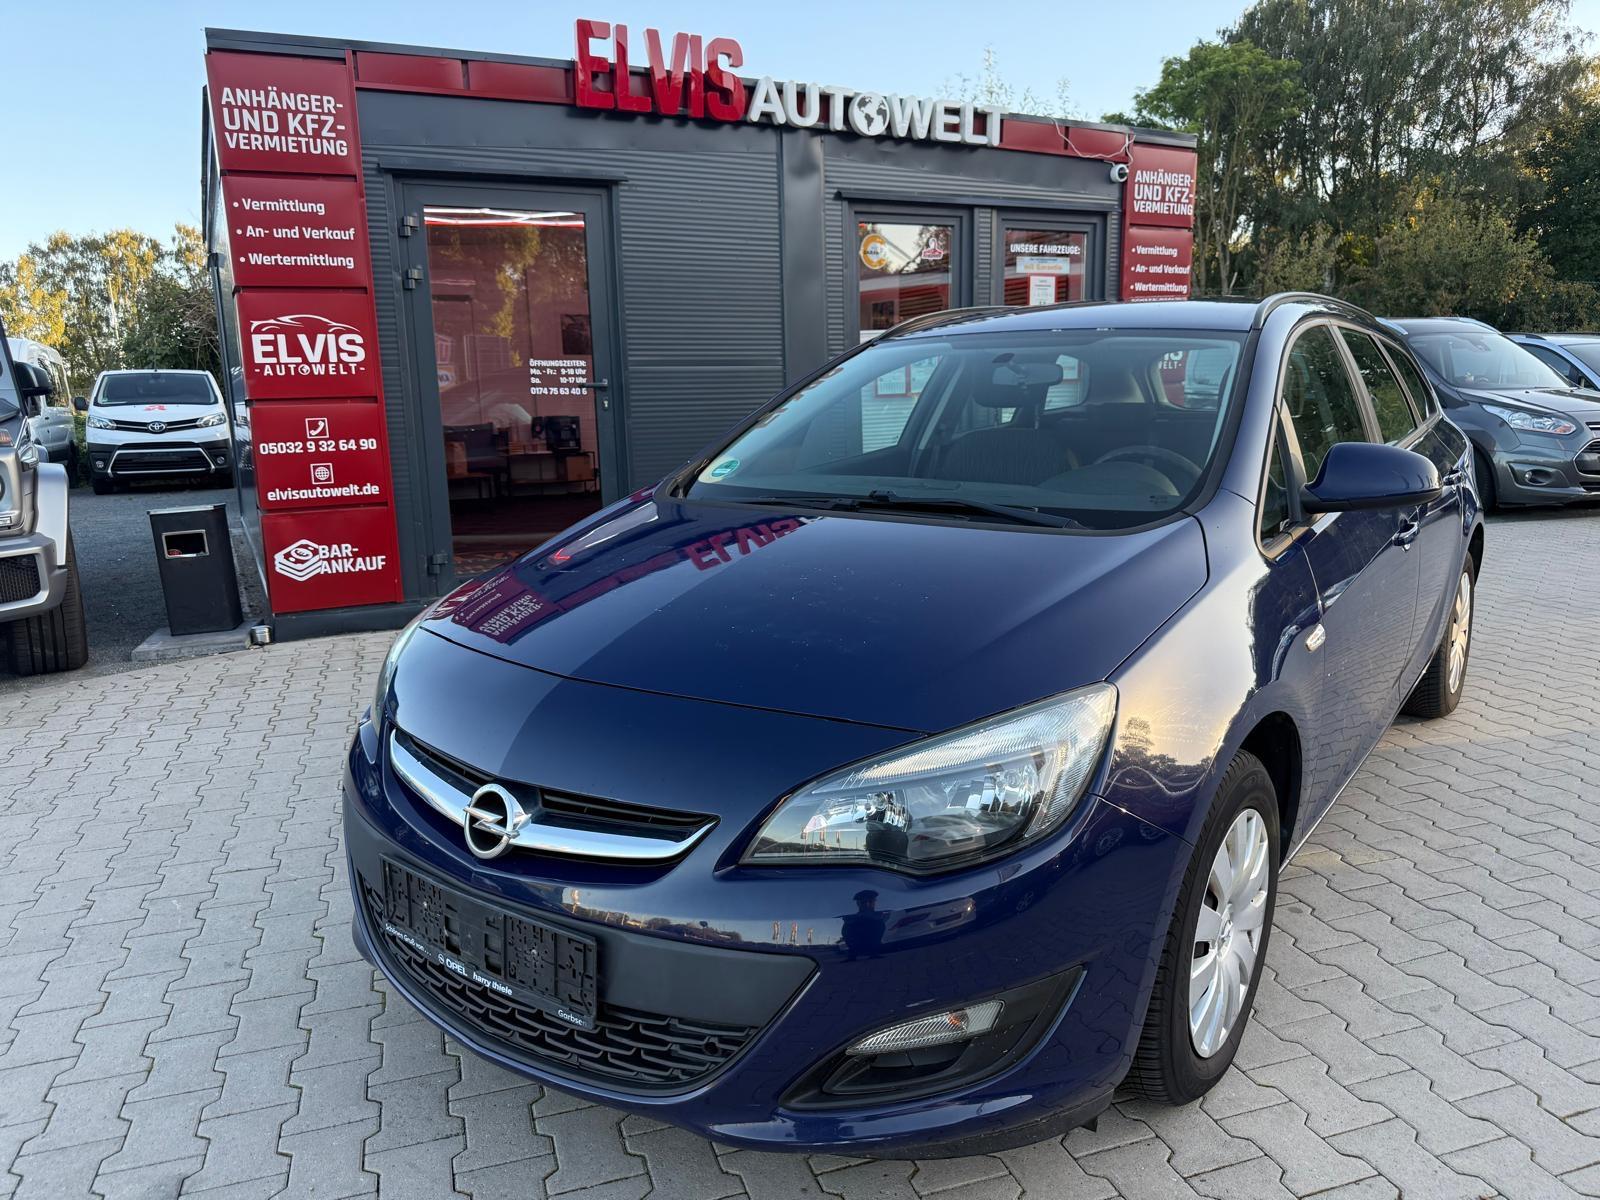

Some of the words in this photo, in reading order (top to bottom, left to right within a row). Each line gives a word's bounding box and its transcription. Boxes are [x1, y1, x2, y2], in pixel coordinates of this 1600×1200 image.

[574, 18, 745, 122] ELVIS
[747, 75, 1008, 147] AUTOWELT
[221, 86, 343, 114] ANHÄNGER-
[222, 108, 279, 133] UND
[287, 112, 346, 138] KFZ-
[224, 132, 348, 156] VERMIETUNG
[1134, 168, 1194, 187] ANHÄNGER-
[1134, 186, 1162, 200] UND
[1165, 187, 1193, 203] KFZ-
[242, 198, 325, 216] Vermittlung
[1133, 200, 1193, 216] VERMIETUNG
[246, 225, 270, 238] An-
[273, 226, 299, 239] und
[303, 227, 356, 241] Verkauf
[1010, 243, 1039, 253] UNSERE
[1040, 244, 1081, 254] FAHRZEUGE:
[1136, 245, 1178, 258] Vermittlung
[248, 252, 354, 269] Wertermittlung
[1135, 264, 1148, 272] An-
[1149, 264, 1162, 273] und
[1164, 265, 1190, 274] Verkauf
[1134, 282, 1188, 294] Wertermittlung
[251, 333, 366, 364] ELVIS
[529, 358, 587, 366] ÖFFNUNGSZEITEN:
[530, 387, 548, 395] 0174
[549, 387, 558, 395] 75
[570, 387, 581, 395] 40
[582, 387, 588, 395] 6
[259, 442, 304, 454] 05032
[306, 441, 316, 454] 9
[318, 440, 336, 453] 32
[338, 439, 358, 452] 64
[359, 438, 377, 451] 90
[267, 483, 380, 501] elvisautowelt.de
[318, 544, 359, 560] BAR-
[320, 555, 386, 575] ANKAUF
[445, 958, 468, 977] OPEL
[472, 972, 491, 988] harry
[492, 980, 513, 996] thiele
